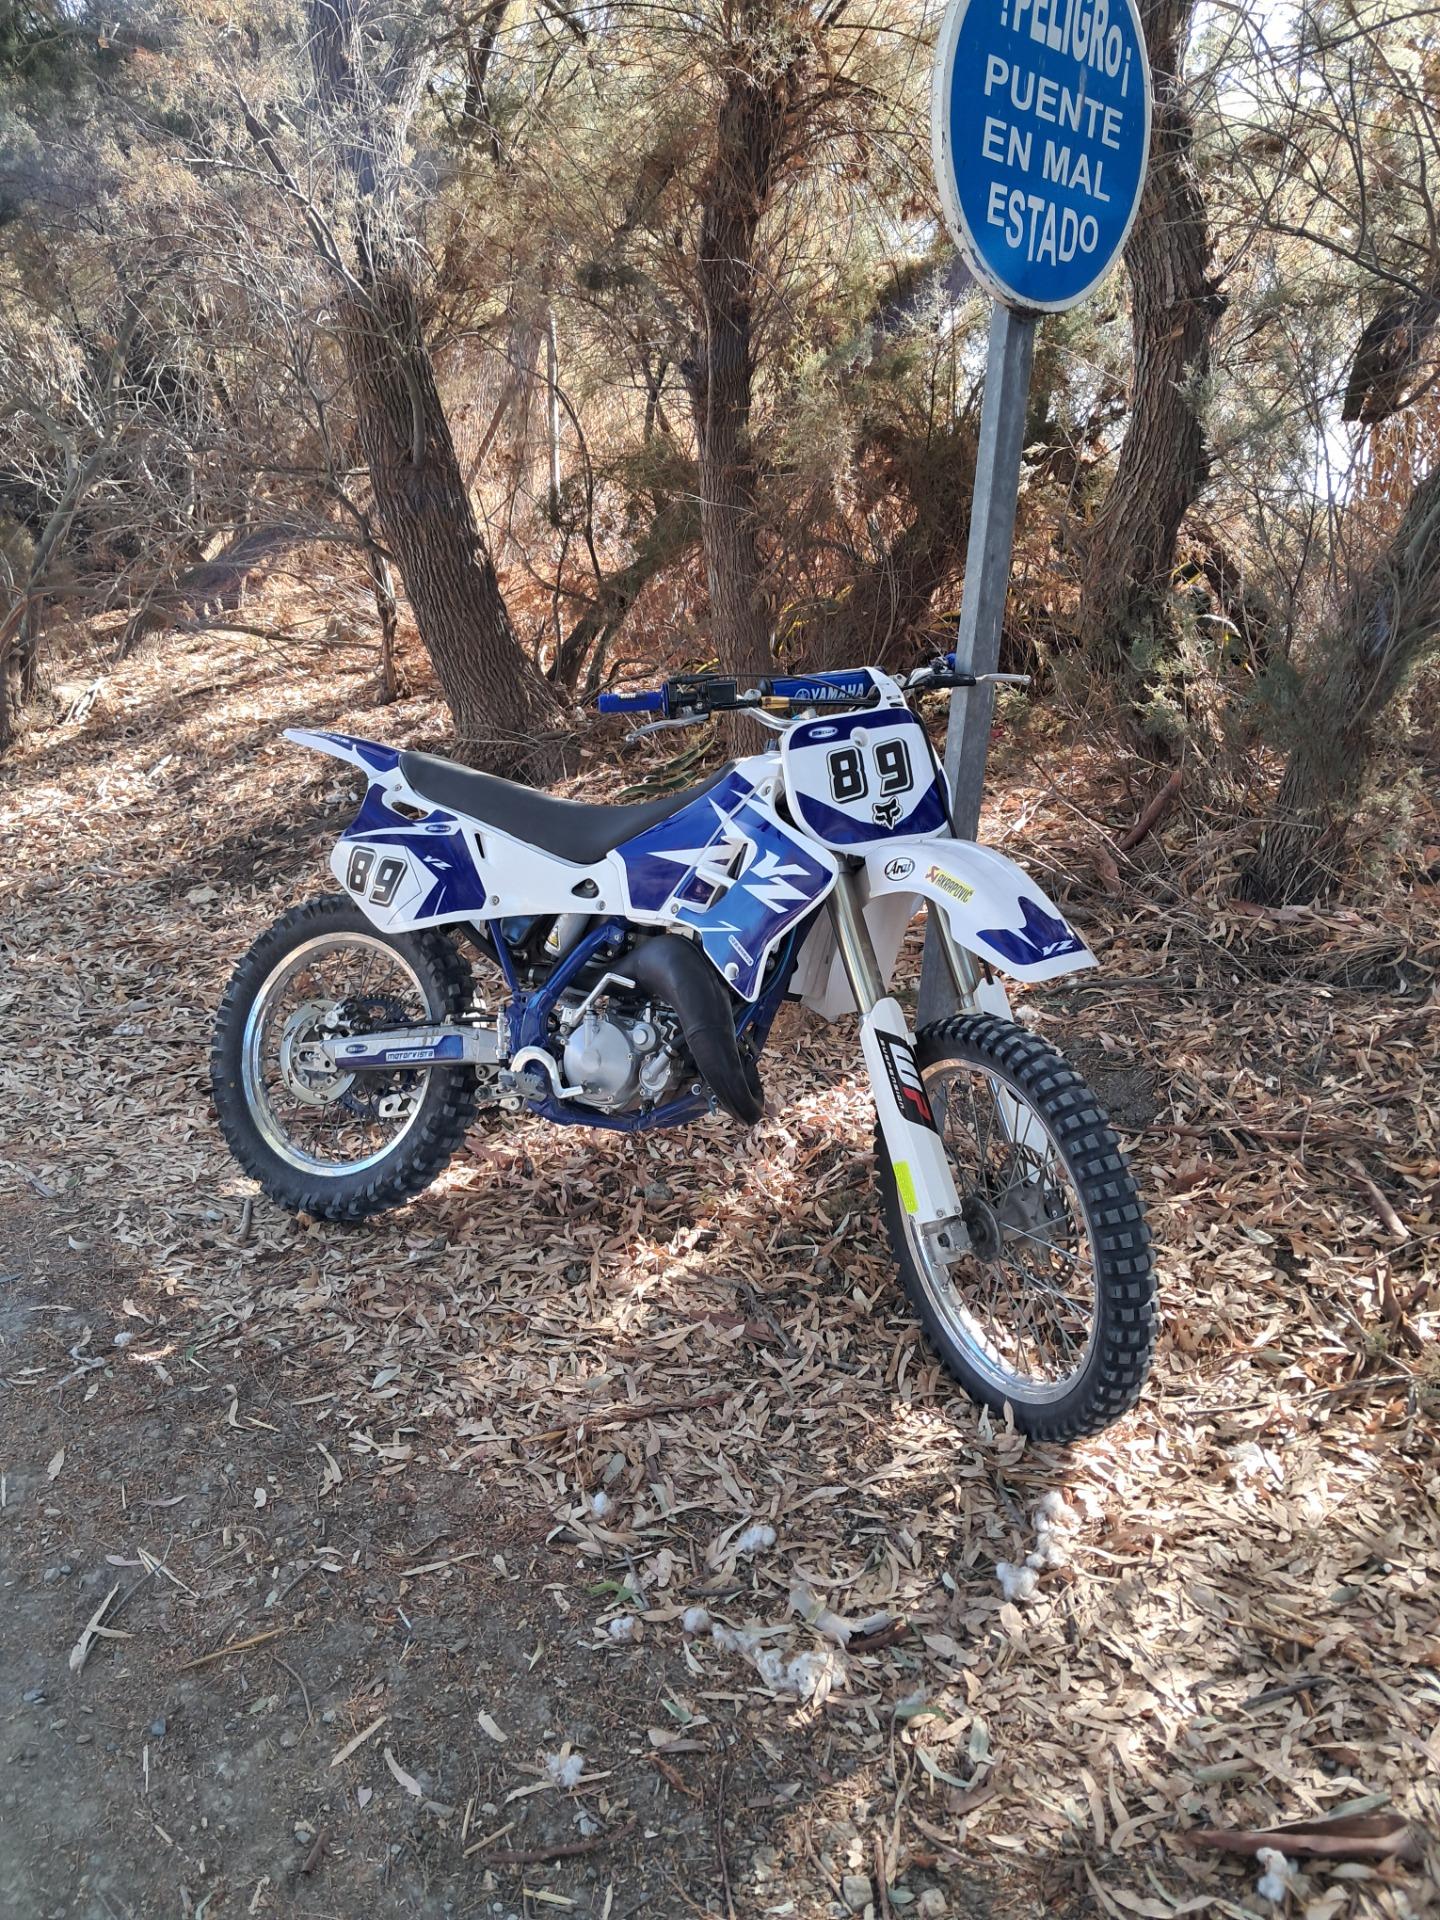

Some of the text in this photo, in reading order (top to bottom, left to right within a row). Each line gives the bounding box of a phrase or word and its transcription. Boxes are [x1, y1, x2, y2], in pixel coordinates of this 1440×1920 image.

[983, 53, 1124, 150] PUENTE
[982, 115, 1110, 202] EN MAL
[987, 181, 1099, 266] ESTADO
[811, 683, 865, 700] YAMAHA
[826, 737, 914, 804] 89
[346, 845, 408, 908] 89
